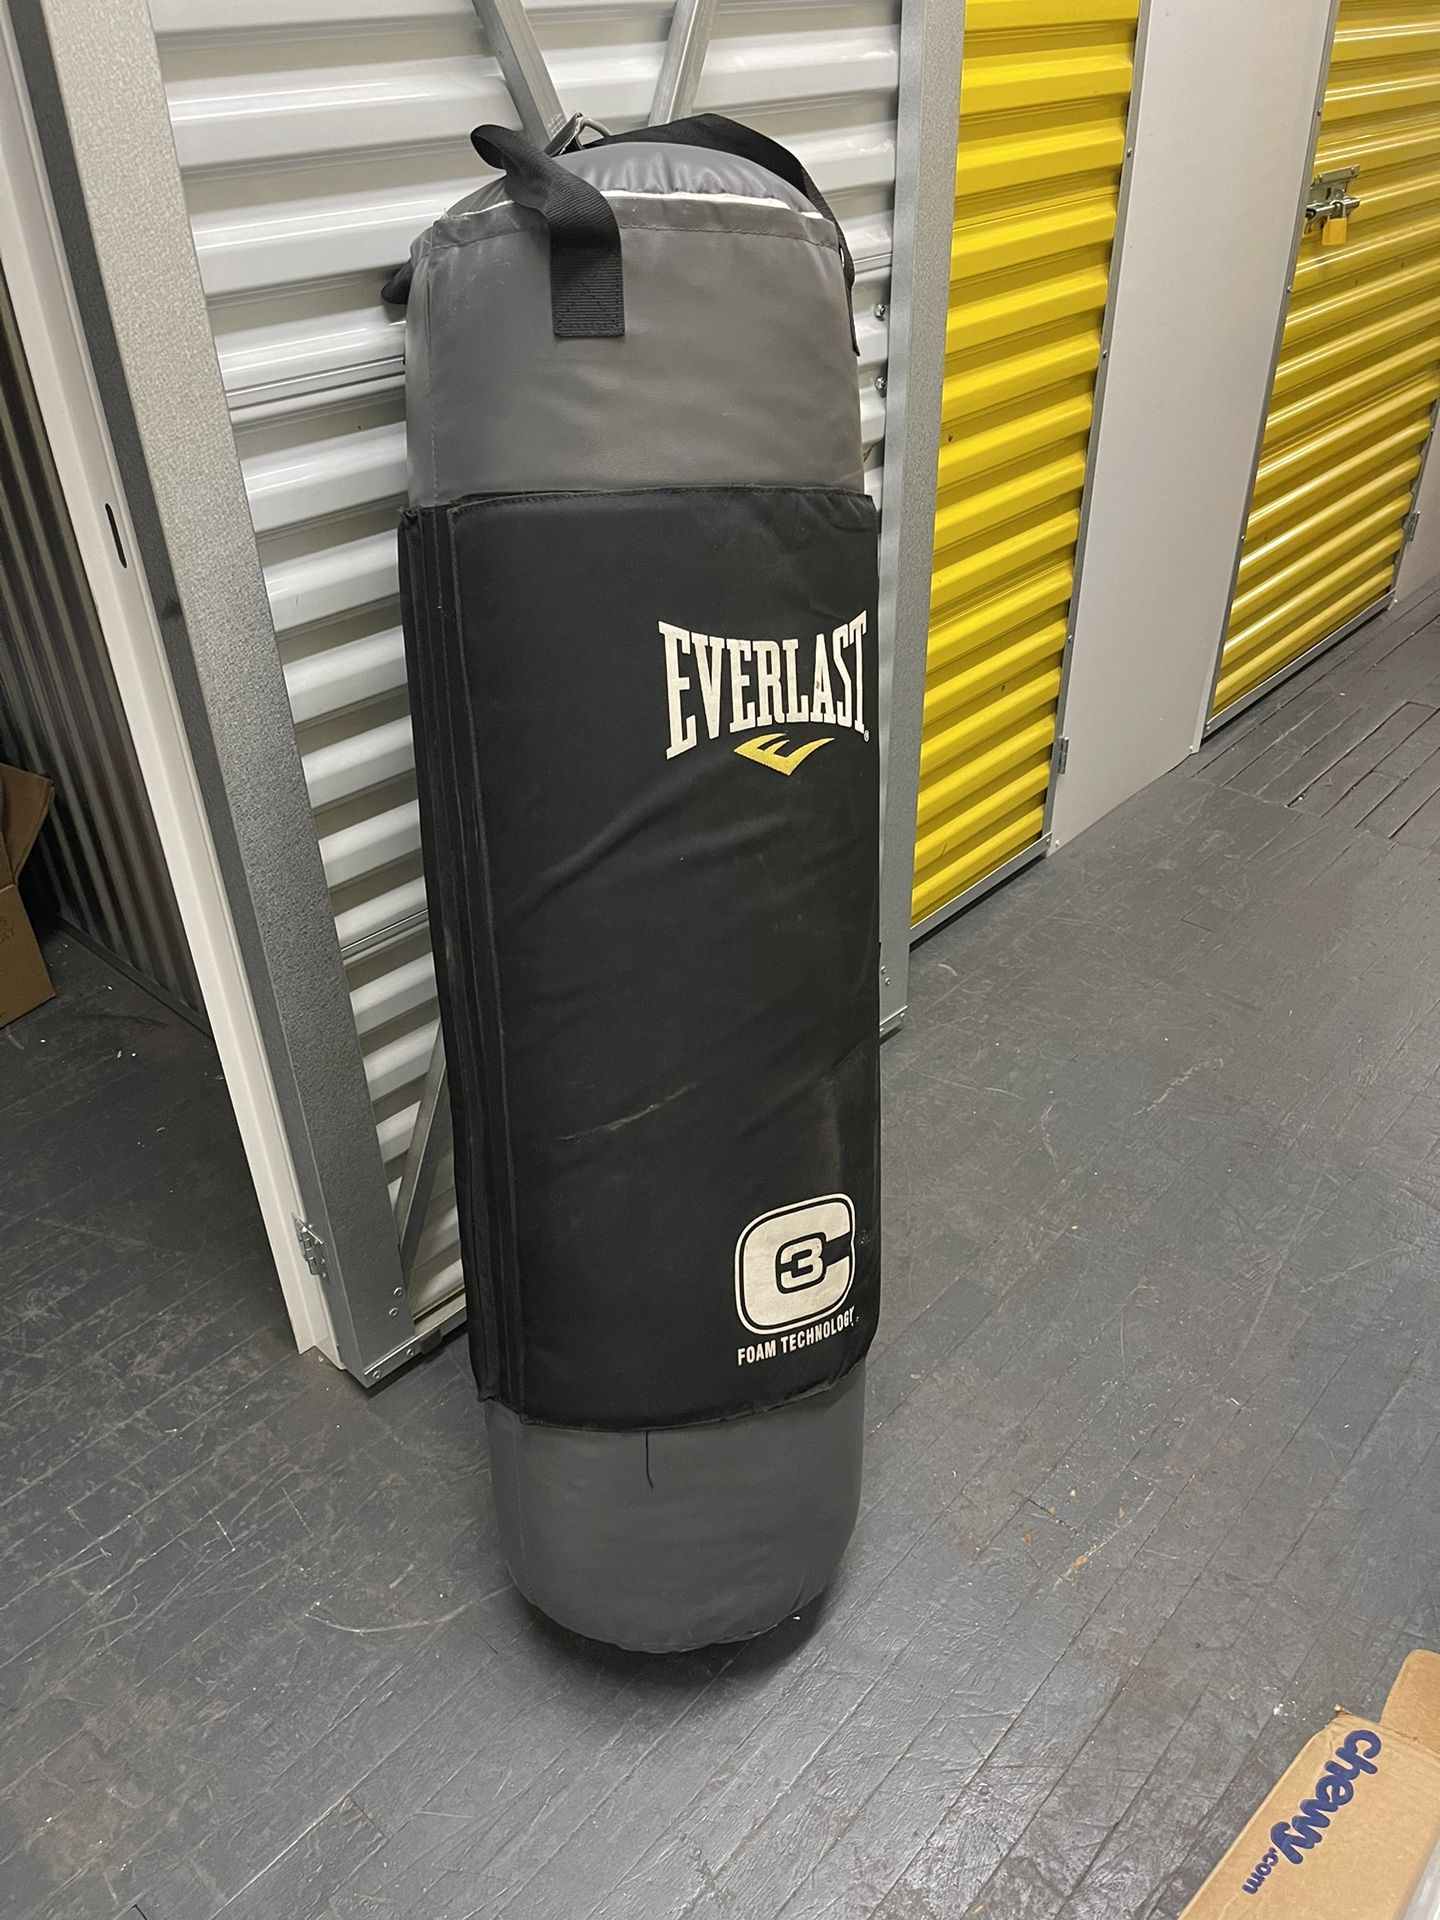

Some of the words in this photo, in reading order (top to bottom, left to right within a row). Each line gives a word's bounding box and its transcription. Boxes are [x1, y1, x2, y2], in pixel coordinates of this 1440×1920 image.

[657, 609, 868, 760] EVERLAST
[737, 1339, 777, 1366] FOAM
[780, 1305, 856, 1354] TECHNOLOGY
